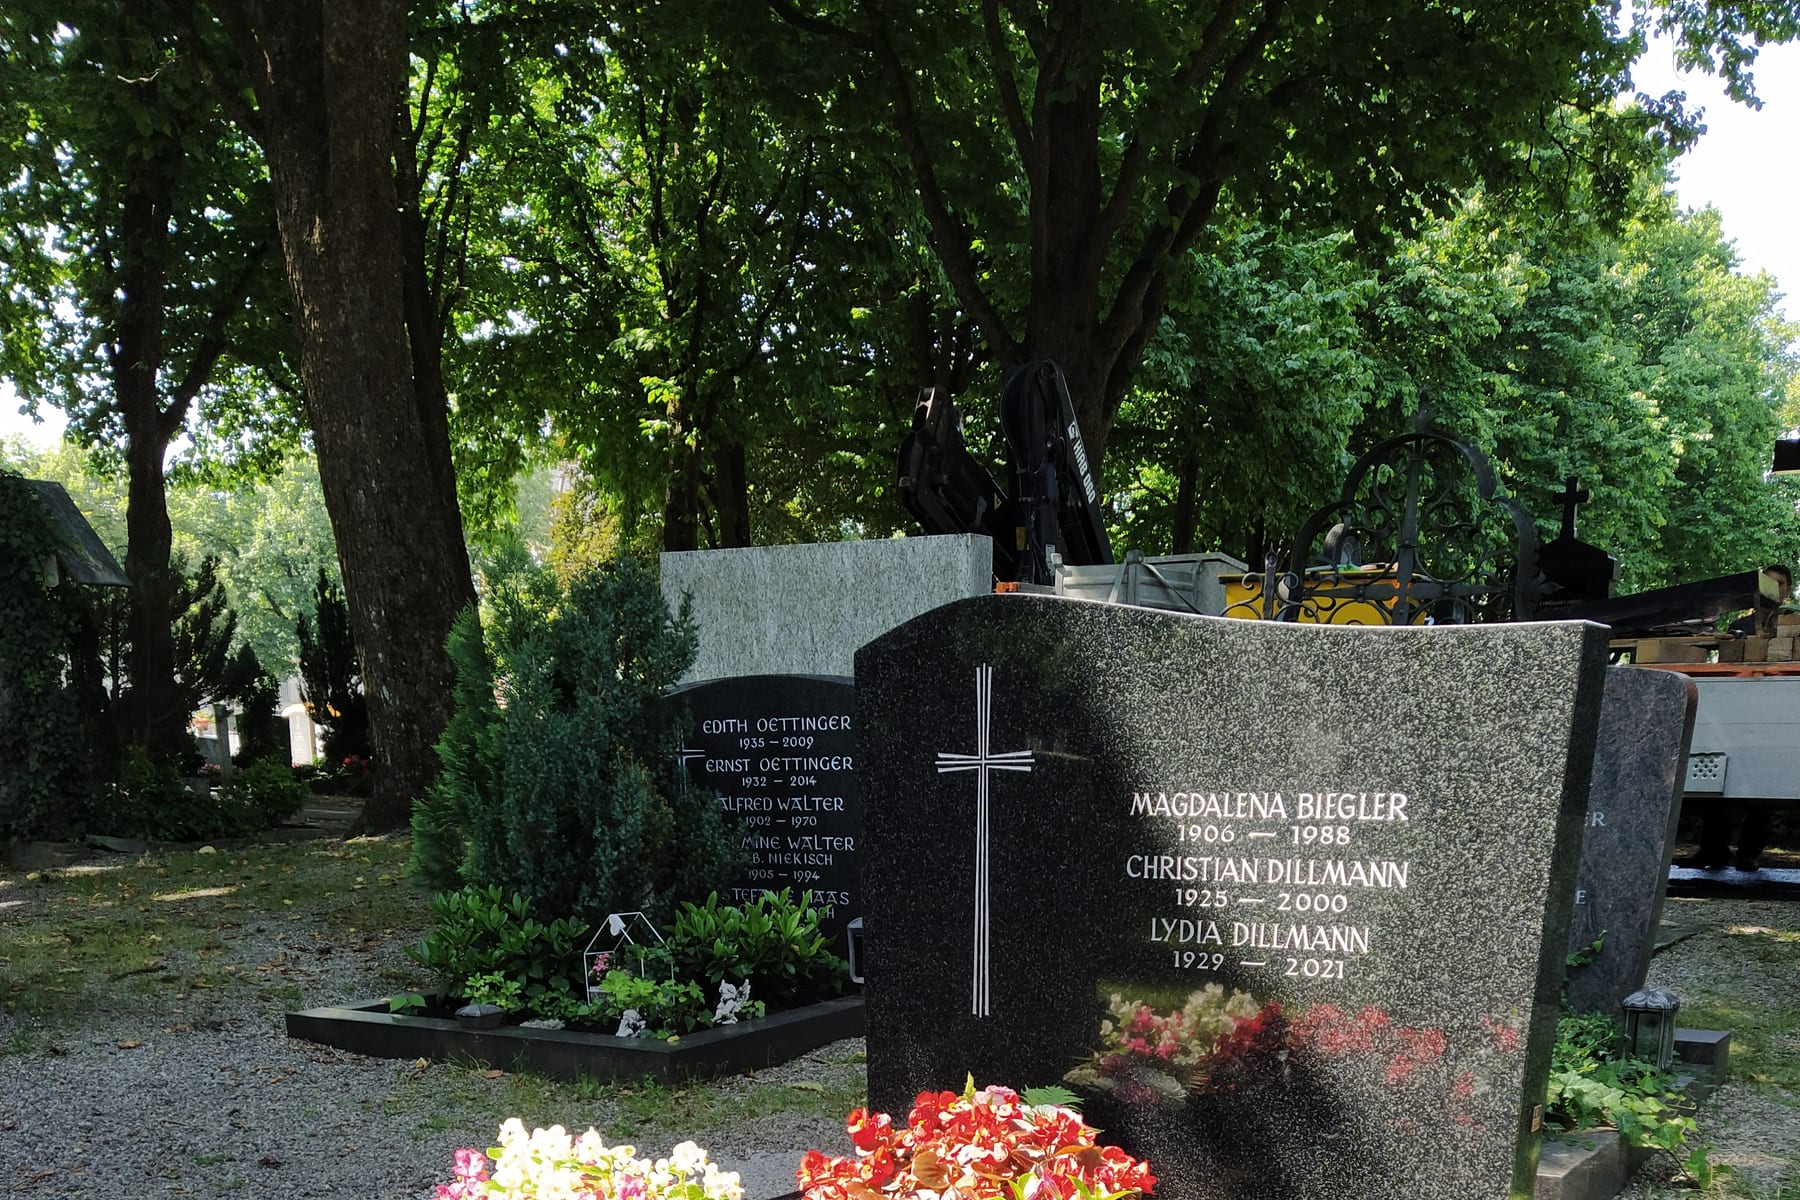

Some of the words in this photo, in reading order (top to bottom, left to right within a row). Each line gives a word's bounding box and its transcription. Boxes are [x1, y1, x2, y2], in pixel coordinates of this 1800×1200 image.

[1073, 438, 1088, 476] HIAB
[703, 719, 748, 734] EDITH
[757, 716, 852, 733] OETTINGER
[739, 738, 765, 748] 1935
[782, 737, 814, 750] 2009
[705, 759, 751, 773] ERNST
[759, 756, 853, 773] OETTINGER
[742, 777, 767, 787] 1932
[790, 776, 817, 787] 2014
[719, 795, 773, 814] ALFRED
[777, 795, 845, 811] WALTER
[1130, 792, 1287, 818] MAGDALENA
[1298, 793, 1409, 821] BIEGLER
[745, 816, 771, 828] 1902
[791, 816, 817, 828] 1970
[787, 834, 855, 851] WALTER
[1178, 825, 1235, 842] 1906
[1292, 825, 1351, 845] 1988
[768, 853, 833, 866] NIEKISCH
[748, 869, 774, 880] 1905
[793, 870, 820, 883] 1994
[1126, 855, 1258, 883] CHRISTIAN
[1268, 858, 1409, 888] DILLMANN
[1175, 889, 1229, 908] 1925
[1277, 893, 1348, 913] 2000
[1150, 917, 1223, 945] LYDIA
[1232, 922, 1370, 953] DILLMANN
[1173, 950, 1224, 971] 1929
[1285, 957, 1344, 979] 2021
